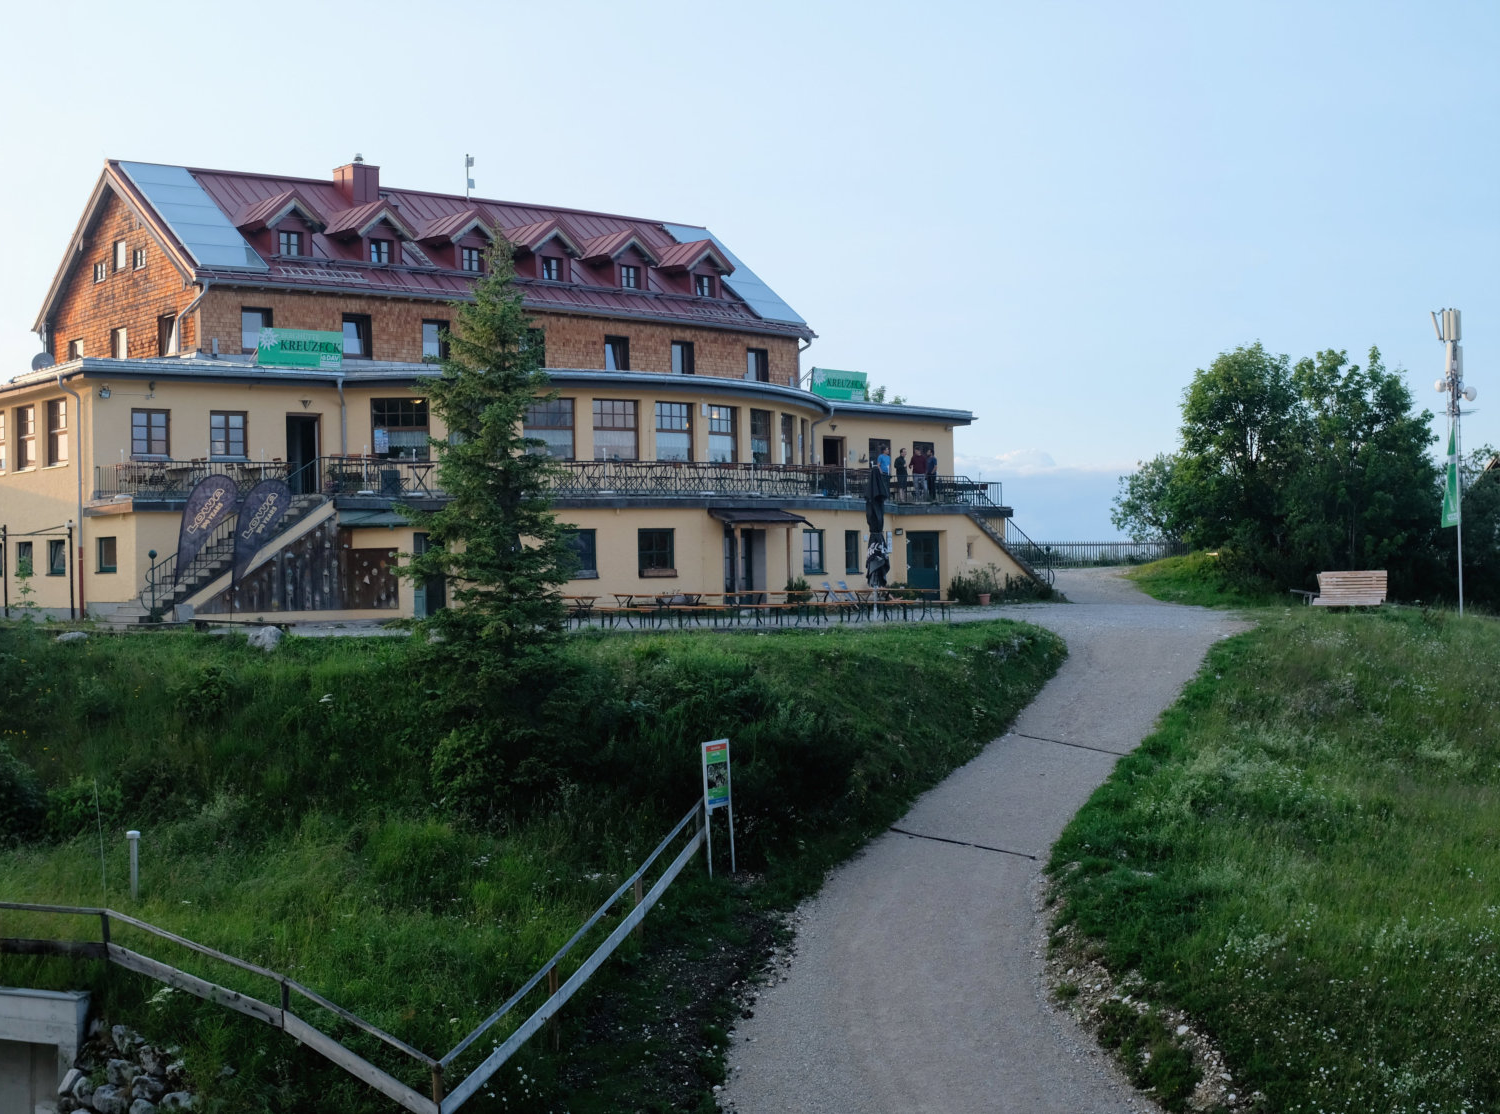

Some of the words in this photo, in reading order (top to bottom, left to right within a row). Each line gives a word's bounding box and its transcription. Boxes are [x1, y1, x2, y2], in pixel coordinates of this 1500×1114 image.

[280, 339, 341, 353] KREUZECK
[827, 378, 864, 389] KREUZECK
[187, 488, 225, 534] LOWA
[209, 502, 223, 520] YEARS
[242, 493, 278, 539] LOWA
[262, 506, 278, 524] YEARS
